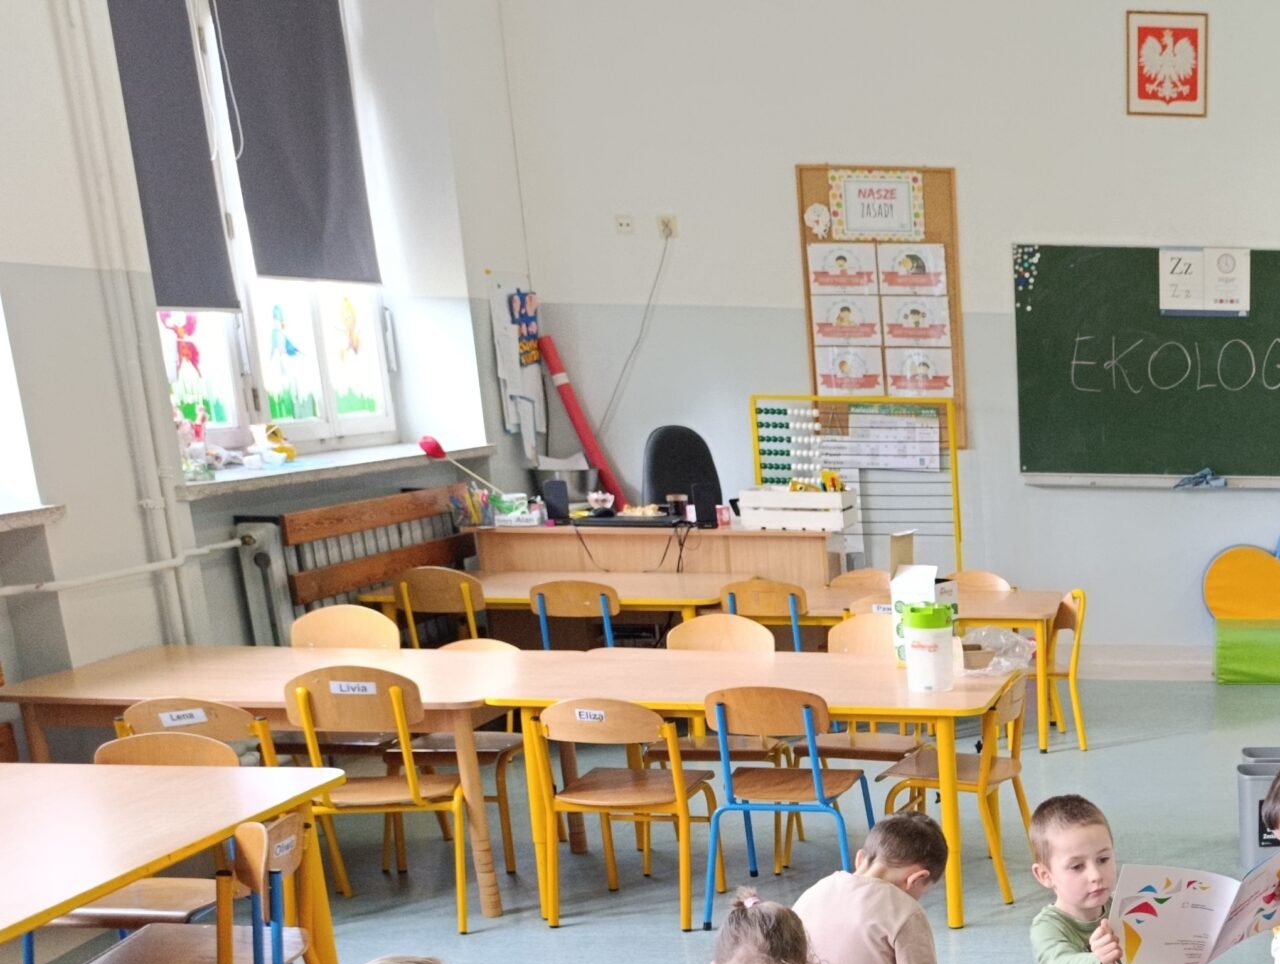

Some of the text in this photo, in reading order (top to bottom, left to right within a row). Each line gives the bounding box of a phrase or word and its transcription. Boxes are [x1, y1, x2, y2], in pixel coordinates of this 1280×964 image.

[857, 187, 897, 200] NASZE
[860, 201, 894, 218] ZASADY
[338, 684, 368, 693] Livia
[169, 711, 195, 722] Lena
[578, 711, 604, 722] Eliza
